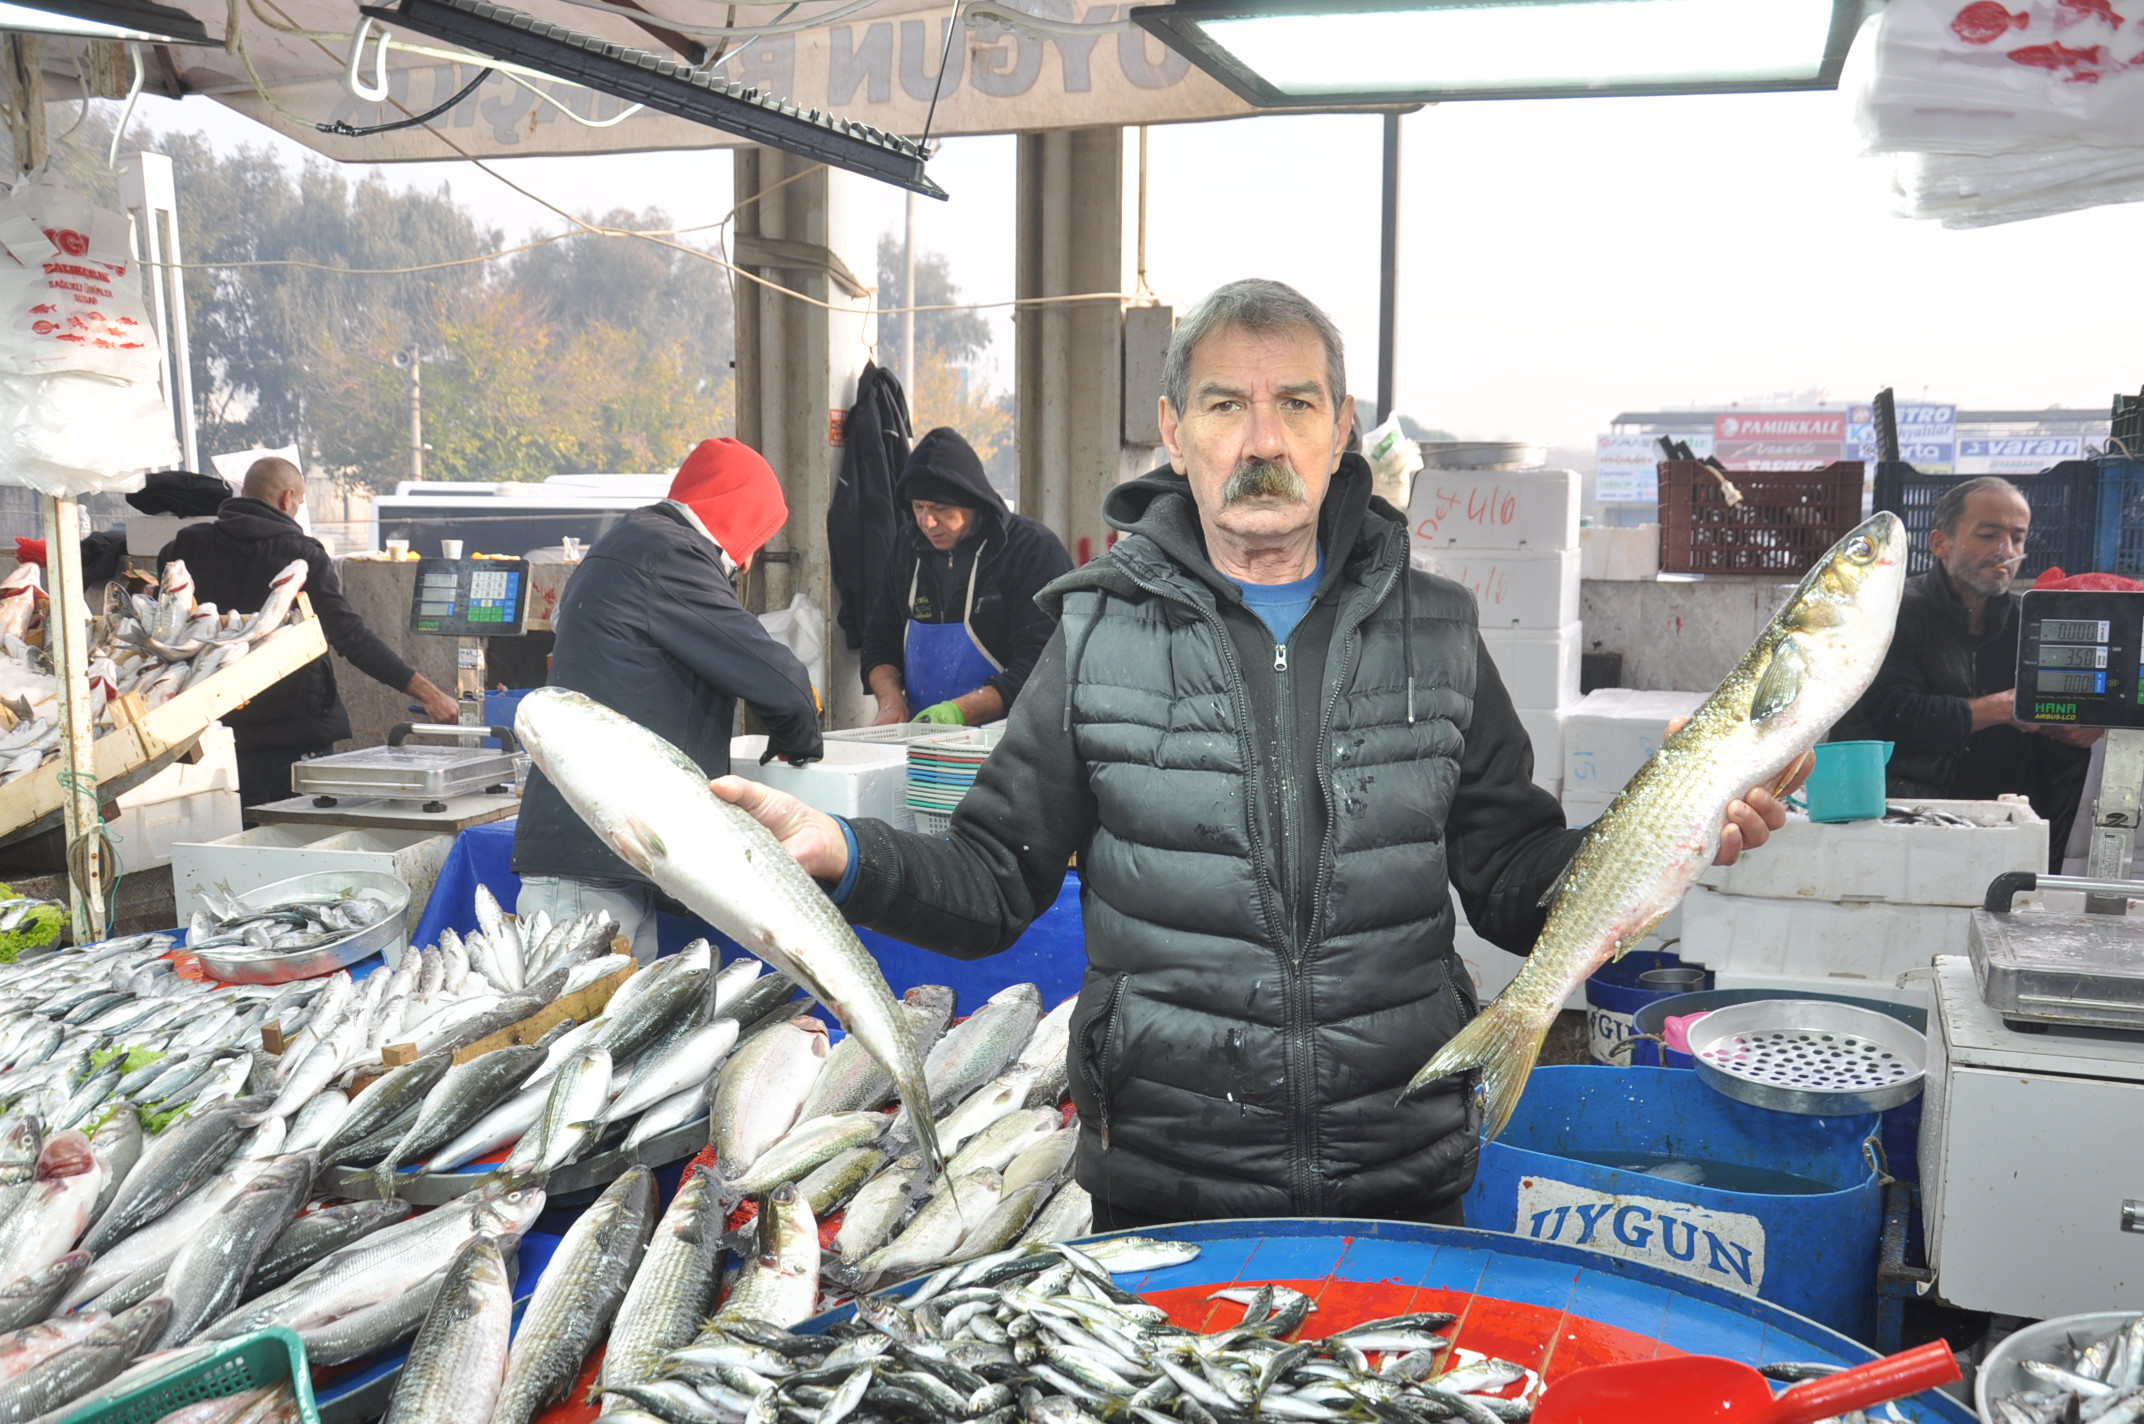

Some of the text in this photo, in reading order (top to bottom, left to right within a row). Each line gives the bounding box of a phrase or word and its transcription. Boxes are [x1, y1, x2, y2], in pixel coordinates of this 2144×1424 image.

[1740, 420, 1840, 435] PAMUKKALE
[1989, 440, 2073, 454] varan
[2035, 702, 2077, 714] HANA
[2034, 713, 2076, 721] AIRBUS-LCD
[1530, 1203, 1753, 1286] UYGUN
